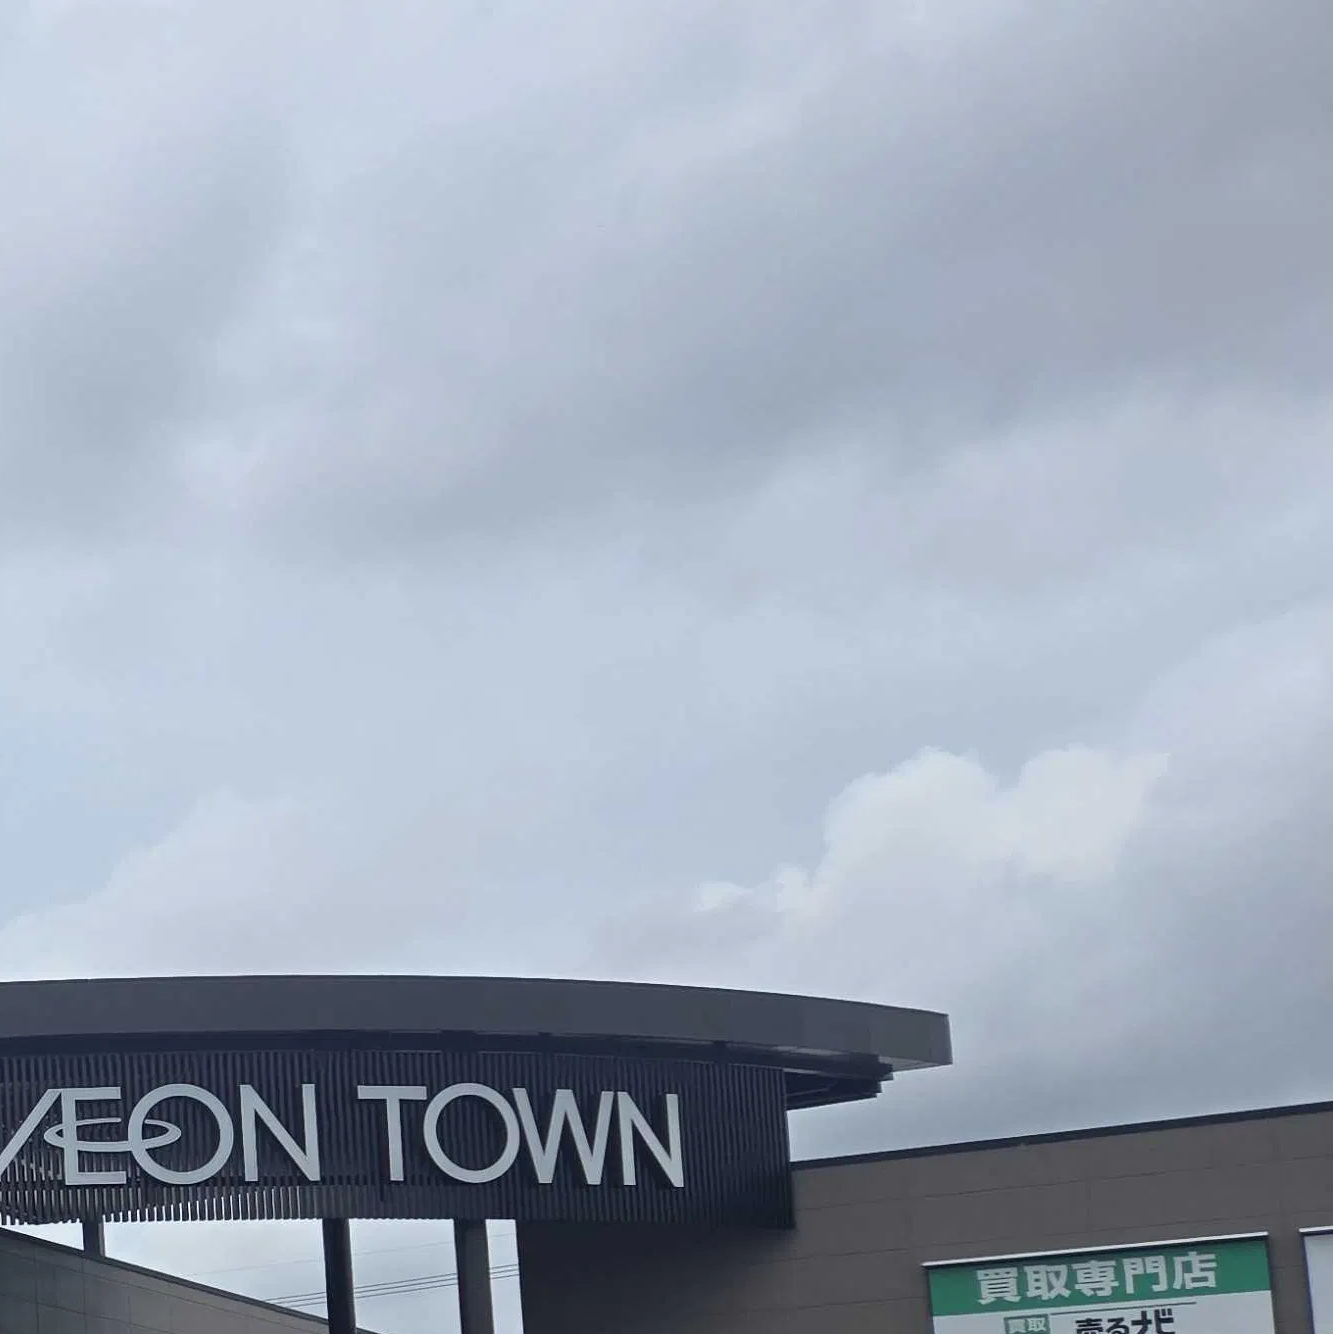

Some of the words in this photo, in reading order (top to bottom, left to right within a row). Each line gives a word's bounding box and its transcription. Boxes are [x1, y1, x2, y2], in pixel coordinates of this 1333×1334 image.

[357, 1083, 684, 1187] TOWN
[976, 1251, 1217, 1305] 買取専門店
